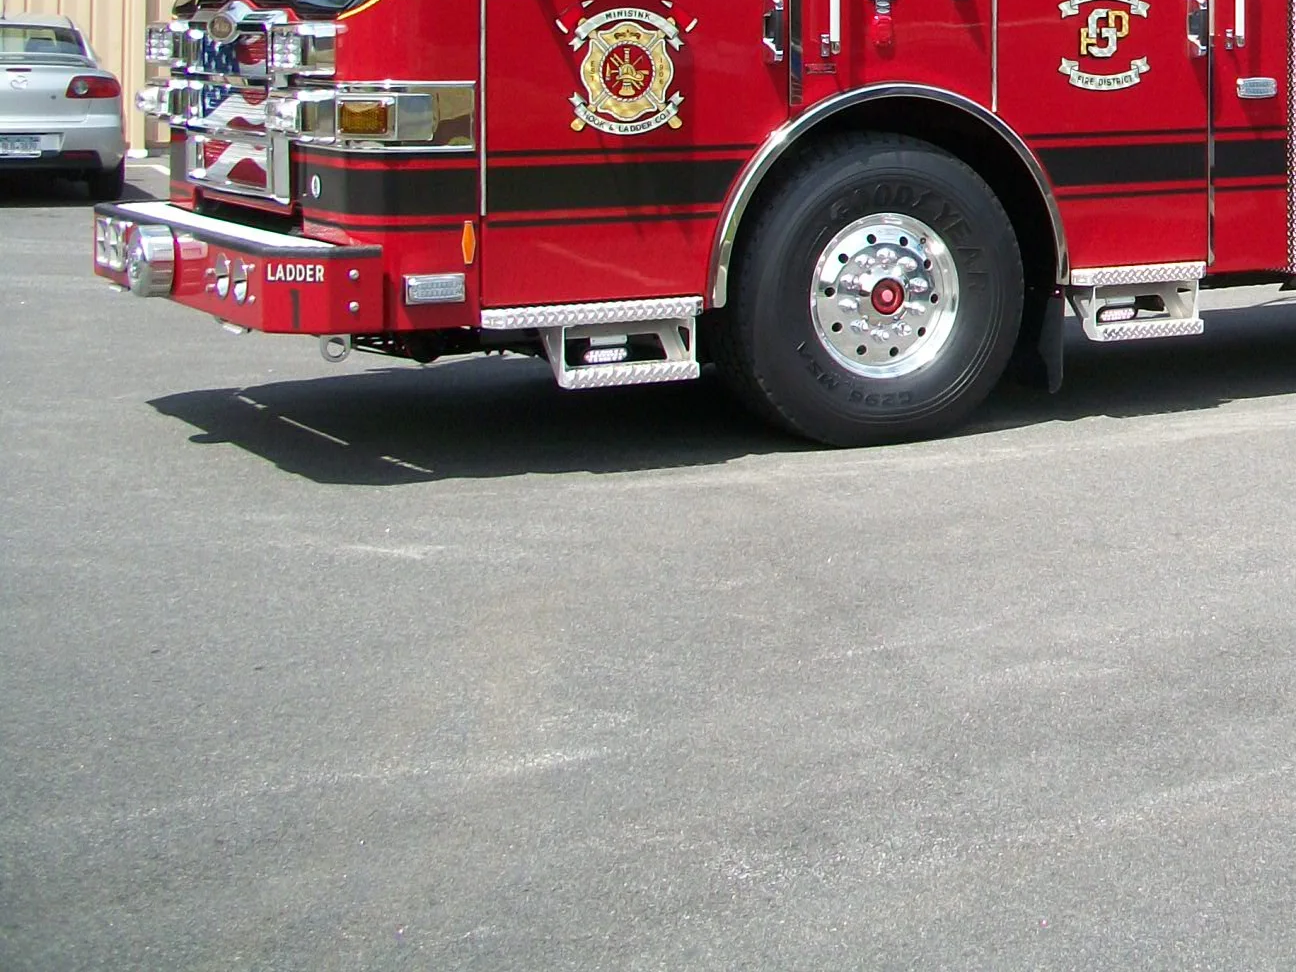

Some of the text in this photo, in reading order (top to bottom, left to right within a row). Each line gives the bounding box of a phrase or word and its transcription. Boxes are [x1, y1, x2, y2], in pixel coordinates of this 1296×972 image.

[605, 9, 651, 20] MINISINK
[1077, 74, 1133, 87] FIRE DISTRICT
[583, 110, 605, 129] HOOK
[618, 120, 653, 132] LADDER
[266, 262, 326, 282] LADDER
[289, 289, 300, 331] 1
